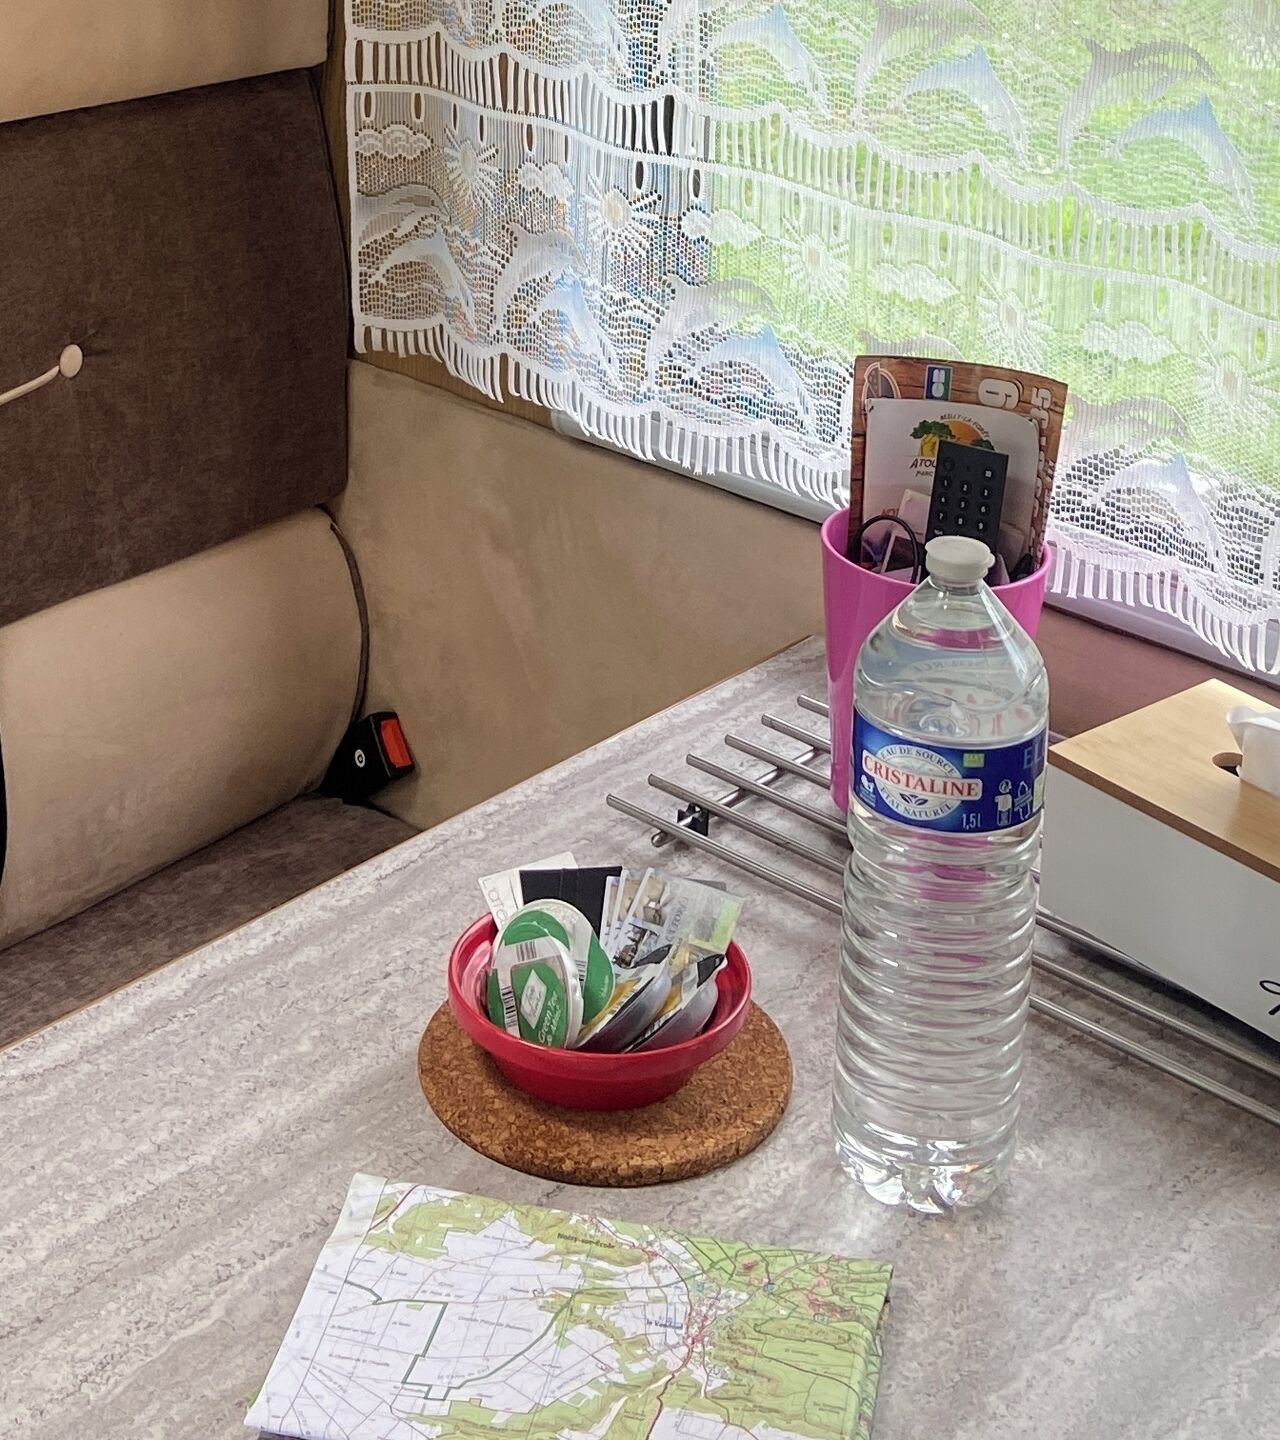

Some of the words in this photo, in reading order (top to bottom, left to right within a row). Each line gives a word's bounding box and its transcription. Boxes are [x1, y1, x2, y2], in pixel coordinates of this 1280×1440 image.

[908, 456, 938, 470] ATOU
[863, 754, 980, 799] CRISTALINE
[880, 745, 898, 760] EAU
[899, 745, 913, 756] DE
[915, 748, 958, 777] SOURCE
[903, 802, 954, 819] NATUREL
[537, 1009, 553, 1044] Green
